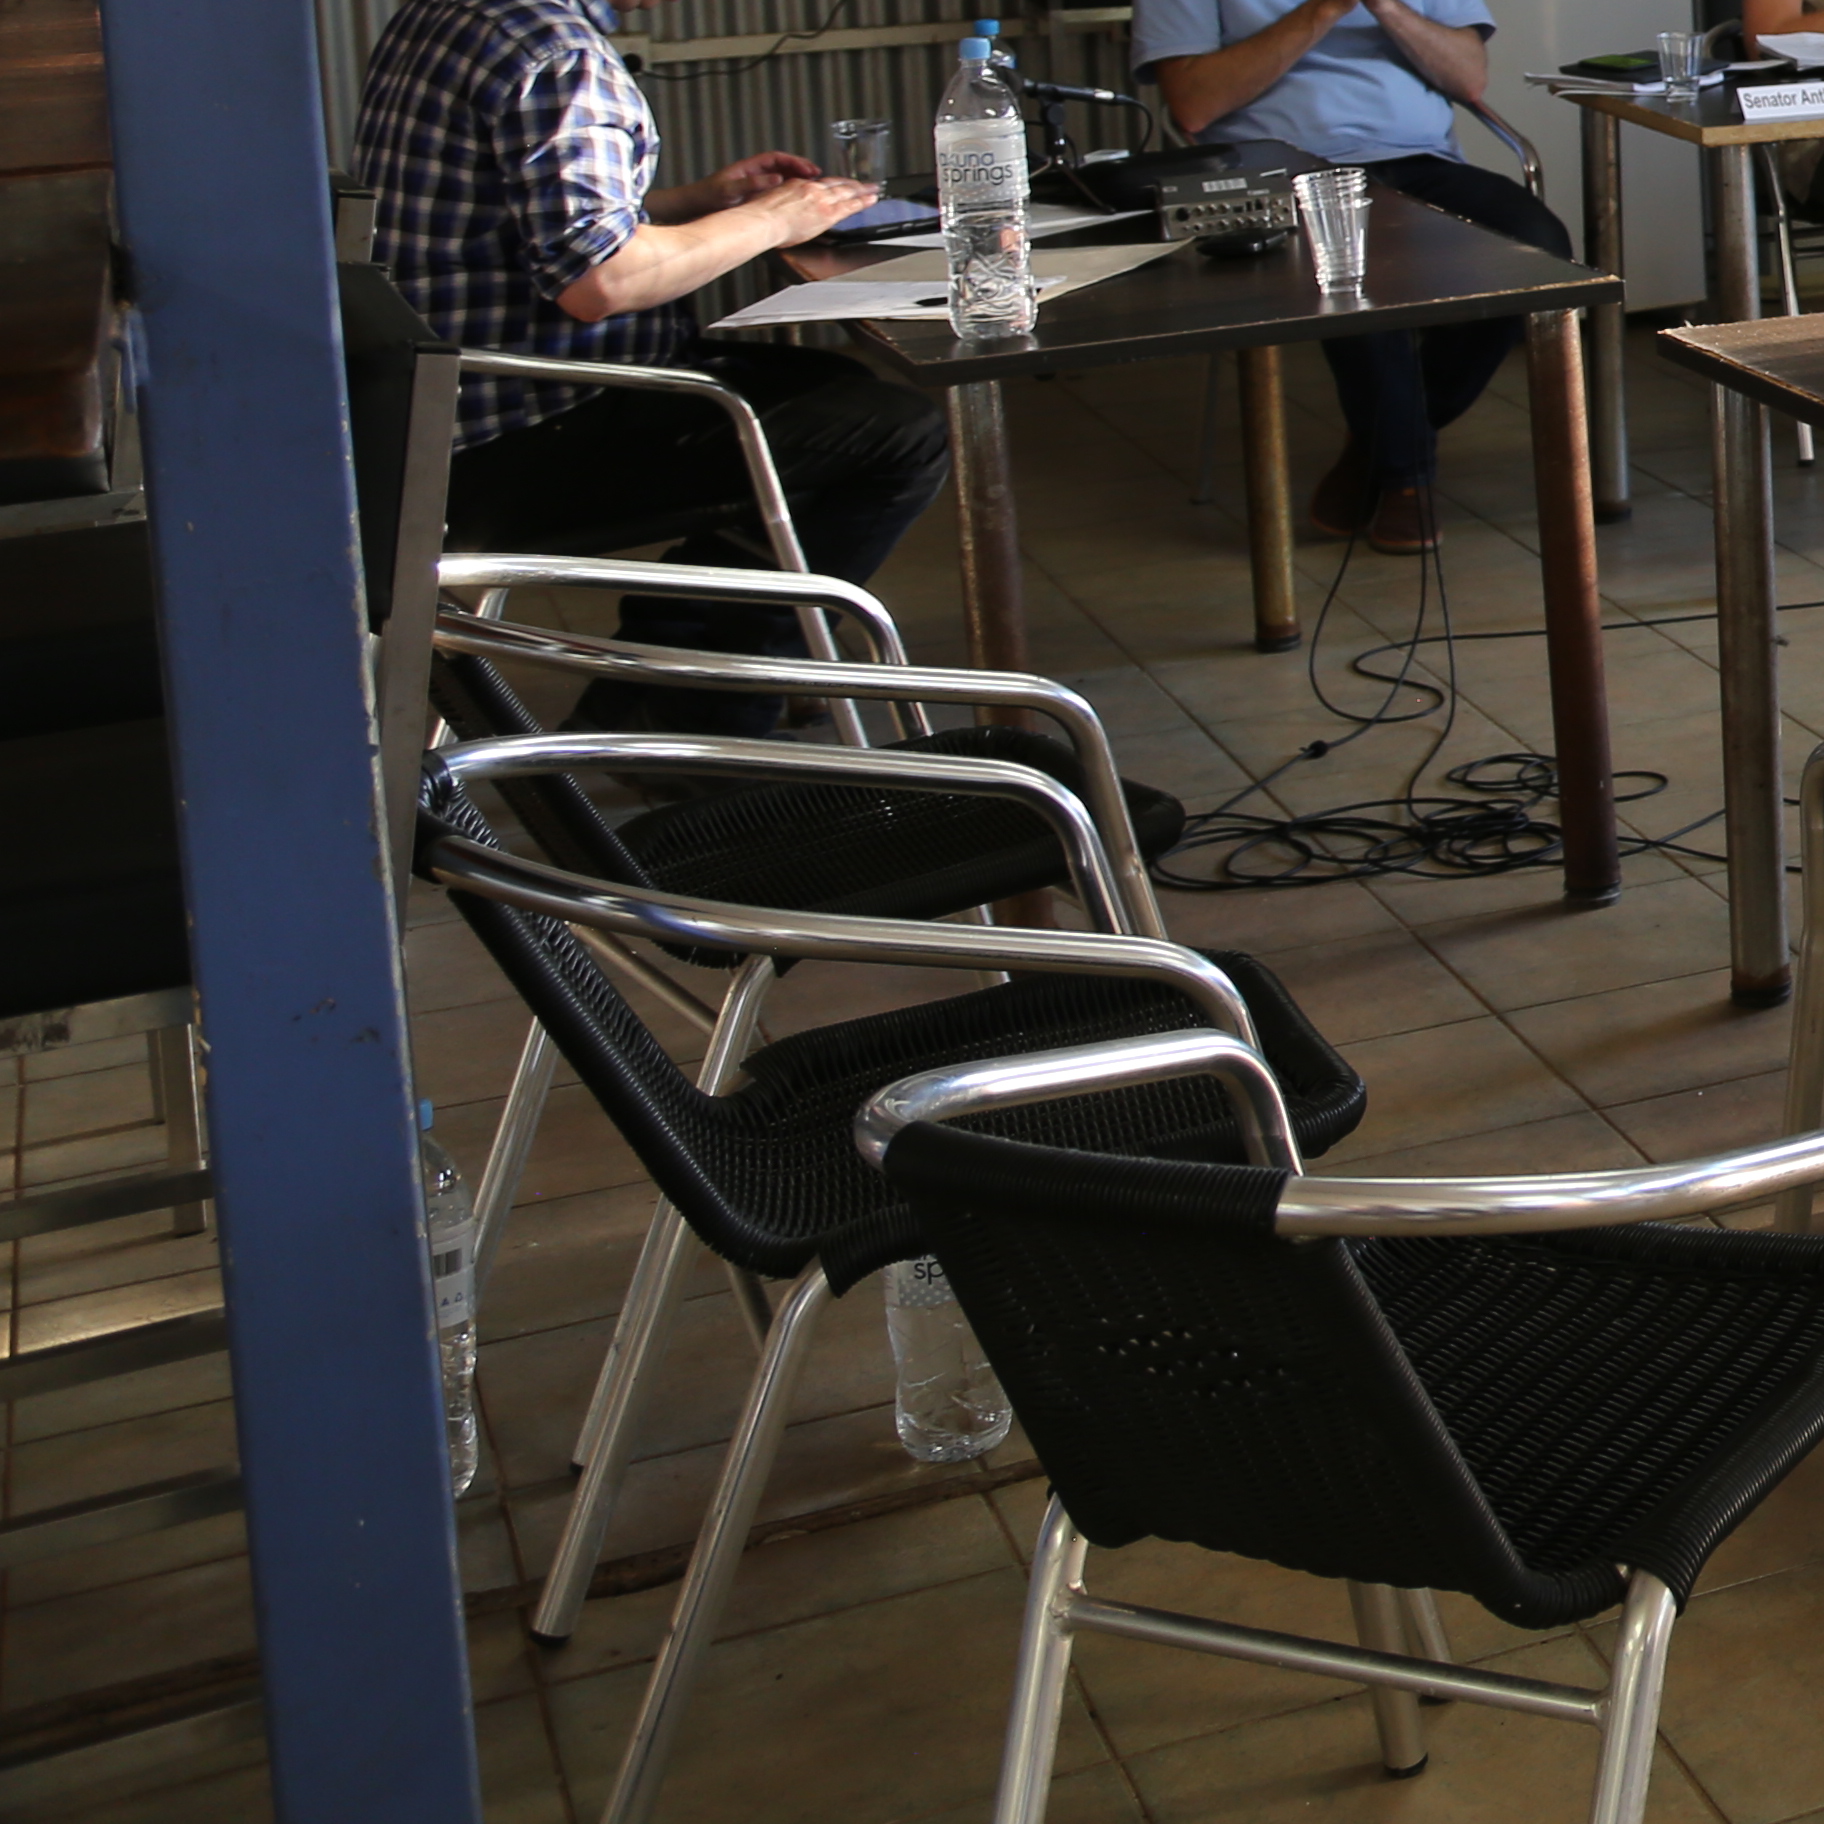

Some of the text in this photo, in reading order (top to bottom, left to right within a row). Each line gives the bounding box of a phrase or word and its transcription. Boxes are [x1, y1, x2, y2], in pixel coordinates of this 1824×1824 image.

[1743, 91, 1797, 109] Senator
[939, 151, 996, 169] akuna
[943, 162, 1013, 186] springs
